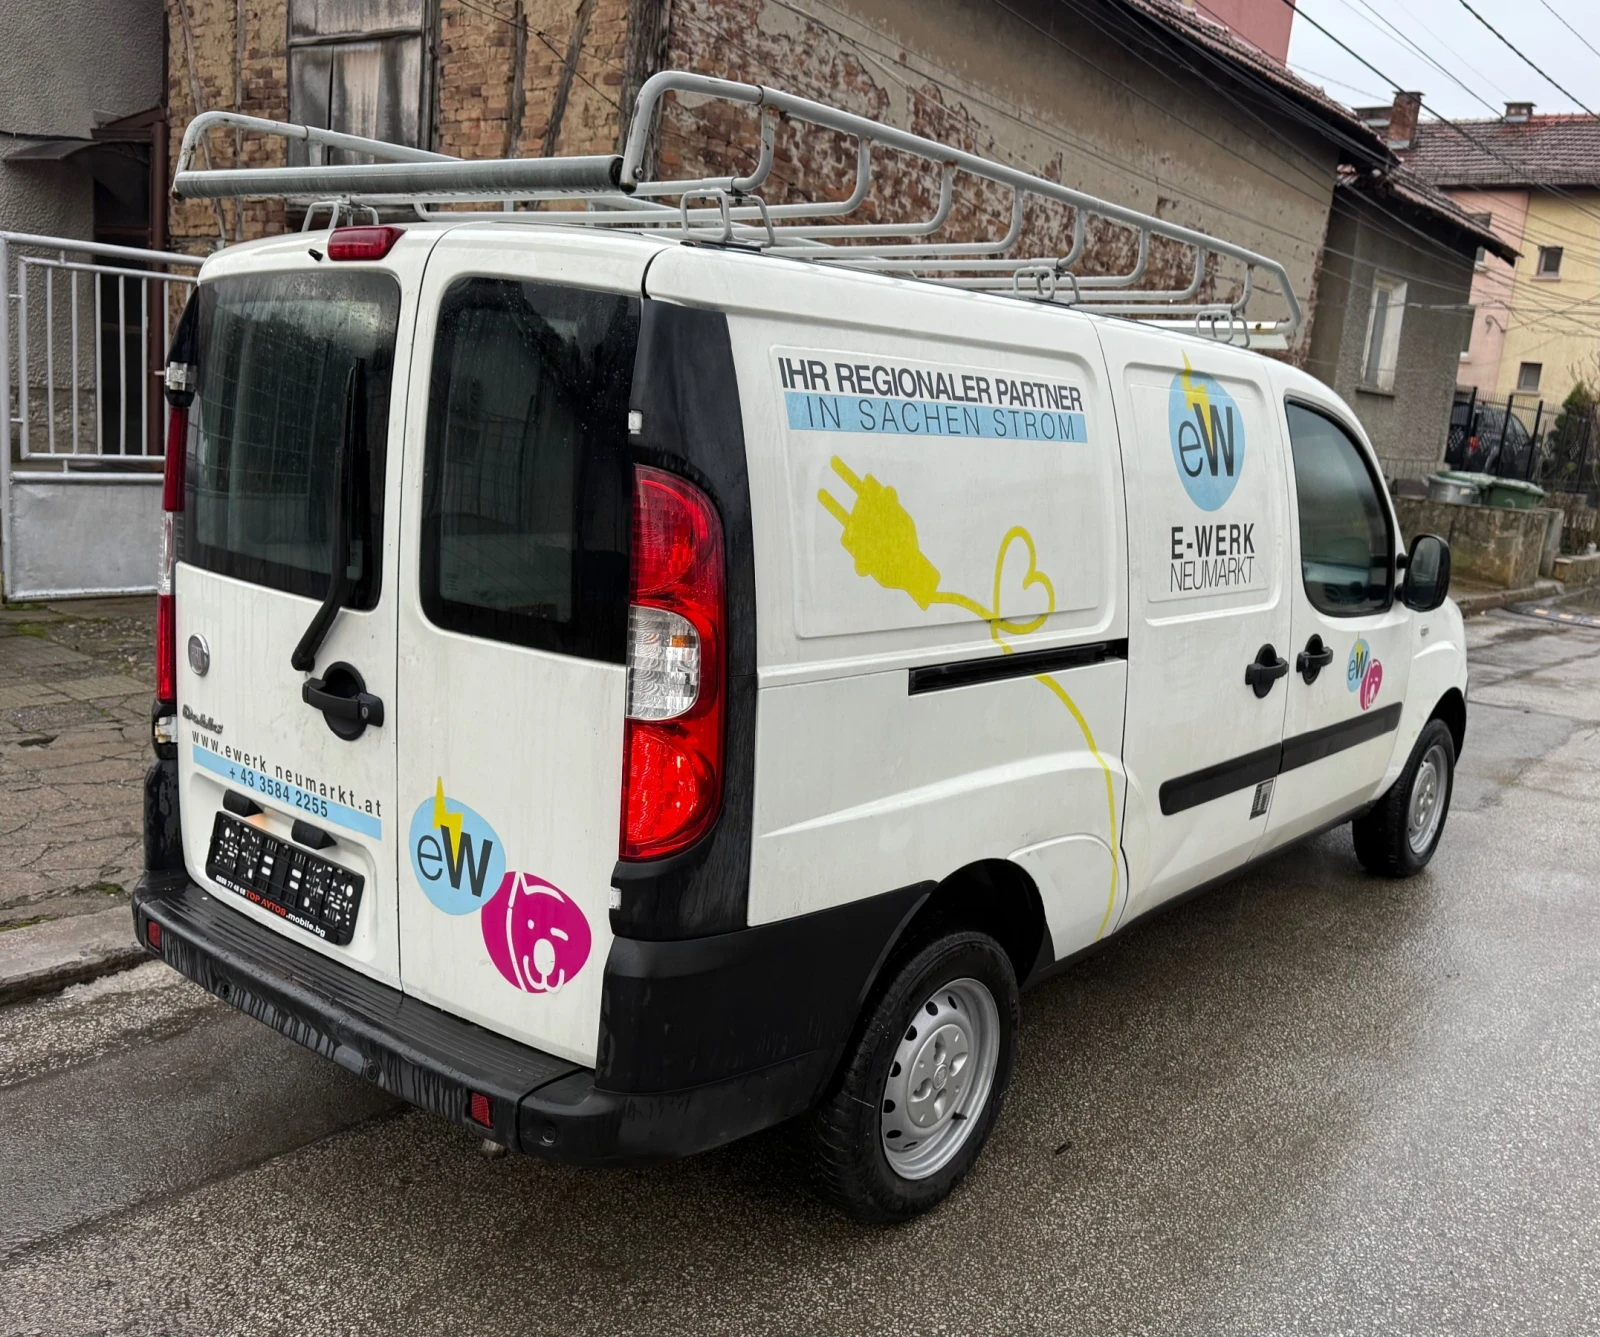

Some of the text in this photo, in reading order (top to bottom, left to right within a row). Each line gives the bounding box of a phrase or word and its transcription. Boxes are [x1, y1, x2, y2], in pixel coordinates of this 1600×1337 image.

[778, 357, 1084, 412] IHR REGIONALER PARTNER
[806, 395, 1076, 441] IN SACHEN STROM
[1171, 523, 1255, 560] E-WERK
[1170, 556, 1255, 593] NEUMARKT
[240, 768, 255, 788] 43
[259, 776, 290, 802] 3584
[295, 790, 328, 818] 2255
[245, 890, 261, 902] TOP
